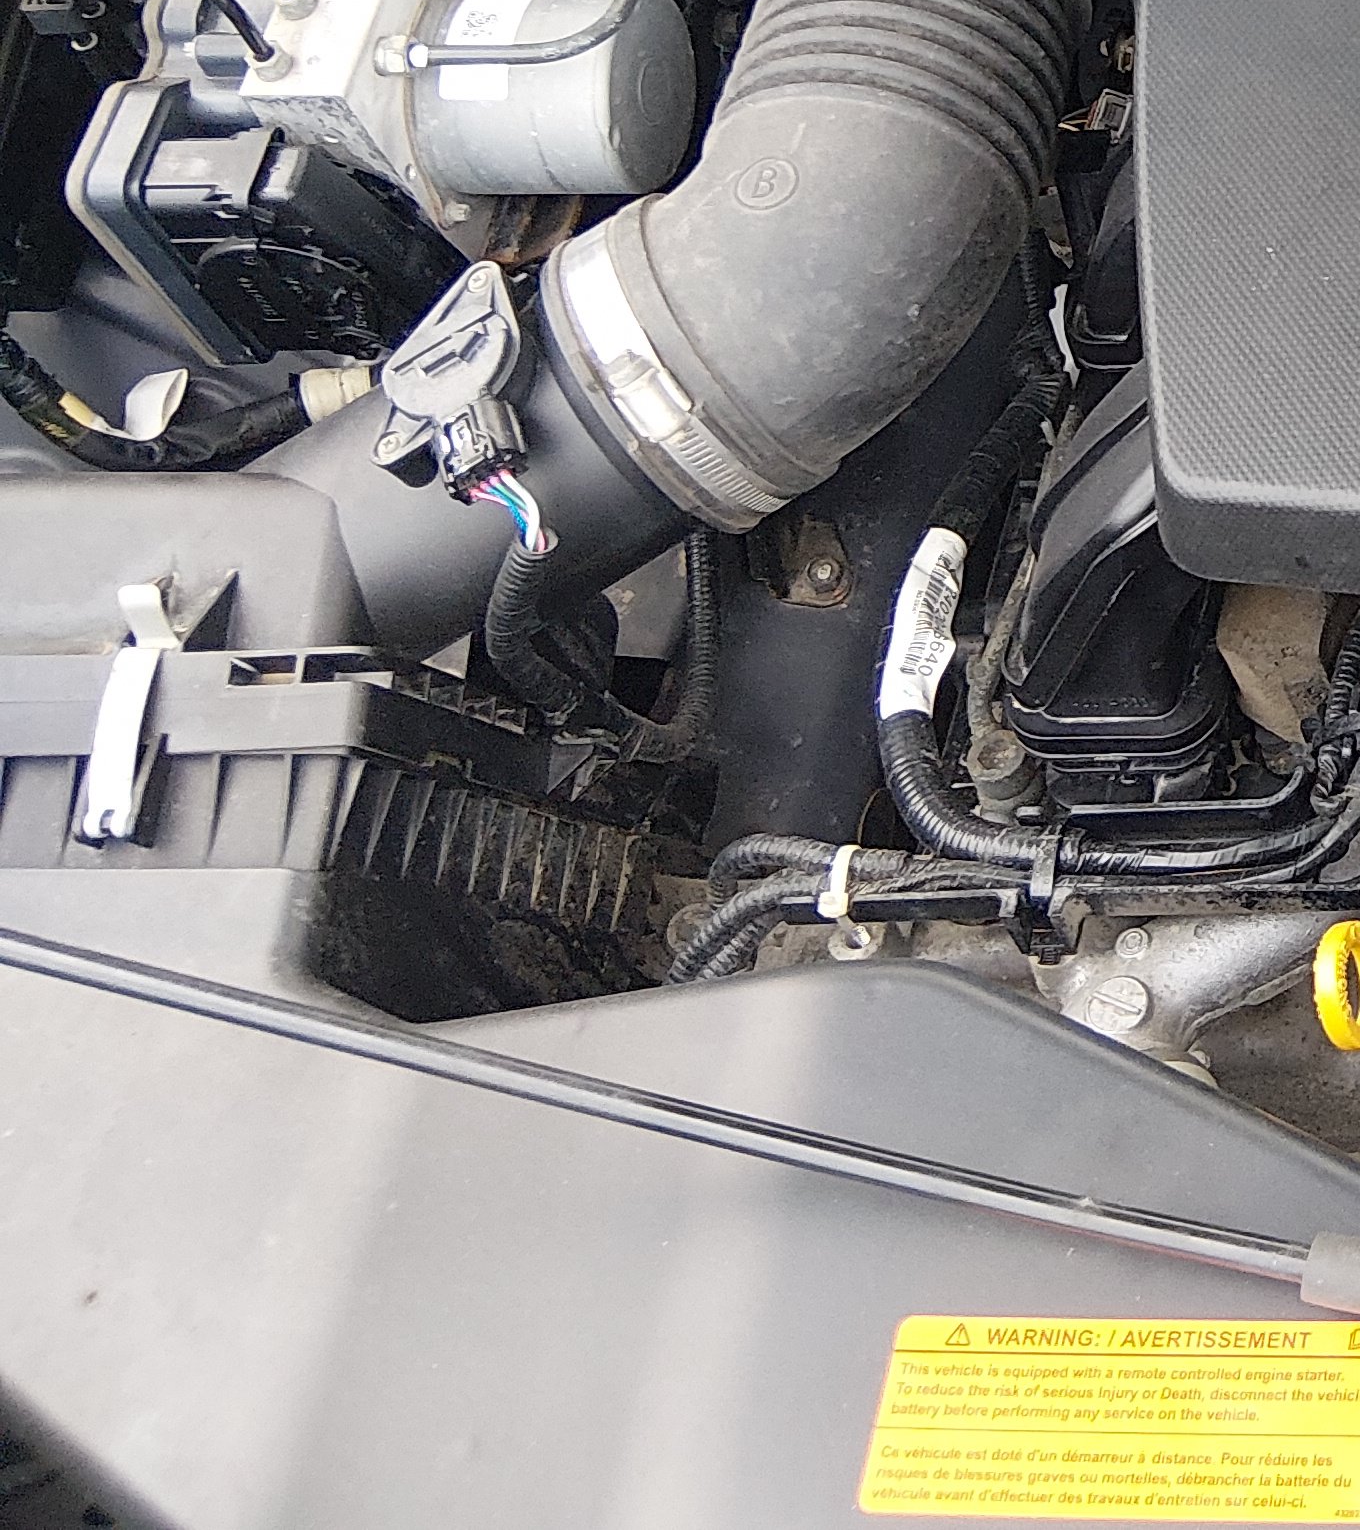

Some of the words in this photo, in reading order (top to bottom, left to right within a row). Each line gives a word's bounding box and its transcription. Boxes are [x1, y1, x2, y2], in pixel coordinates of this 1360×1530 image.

[750, 166, 778, 199] B
[987, 1328, 1101, 1348] WARNING:
[1120, 1330, 1312, 1350] AVERTISSEMENT
[901, 1362, 930, 1376] This
[934, 1365, 984, 1378] vehicle
[988, 1366, 998, 1378] is
[1004, 1366, 1068, 1382] equipped
[1073, 1367, 1102, 1380] with
[1106, 1370, 1114, 1380] a
[1118, 1368, 1166, 1380] remote
[1170, 1369, 1240, 1382] controlled
[1246, 1370, 1292, 1384] engine
[896, 1382, 912, 1396] To
[917, 1384, 964, 1396] reduce
[968, 1385, 990, 1396] the
[995, 1385, 1020, 1398] risk
[1024, 1384, 1038, 1398] of
[1043, 1387, 1094, 1398] serious
[1142, 1389, 1158, 1400] or
[1210, 1389, 1288, 1402] disconnect
[1292, 1390, 1312, 1402] the
[891, 1403, 940, 1420] battery
[944, 1404, 990, 1416] before
[992, 1405, 1070, 1422] performing
[1074, 1408, 1100, 1422] any
[1104, 1406, 1154, 1420] service
[1158, 1410, 1176, 1420] on
[1181, 1408, 1202, 1420] the
[904, 1446, 962, 1460] véhicule
[966, 1448, 988, 1460] est
[991, 1447, 1024, 1462] doté
[1027, 1448, 1058, 1462] d'un
[1062, 1449, 1134, 1464] démarreur
[1221, 1452, 1254, 1466] Pour
[1313, 1454, 1334, 1466] les
